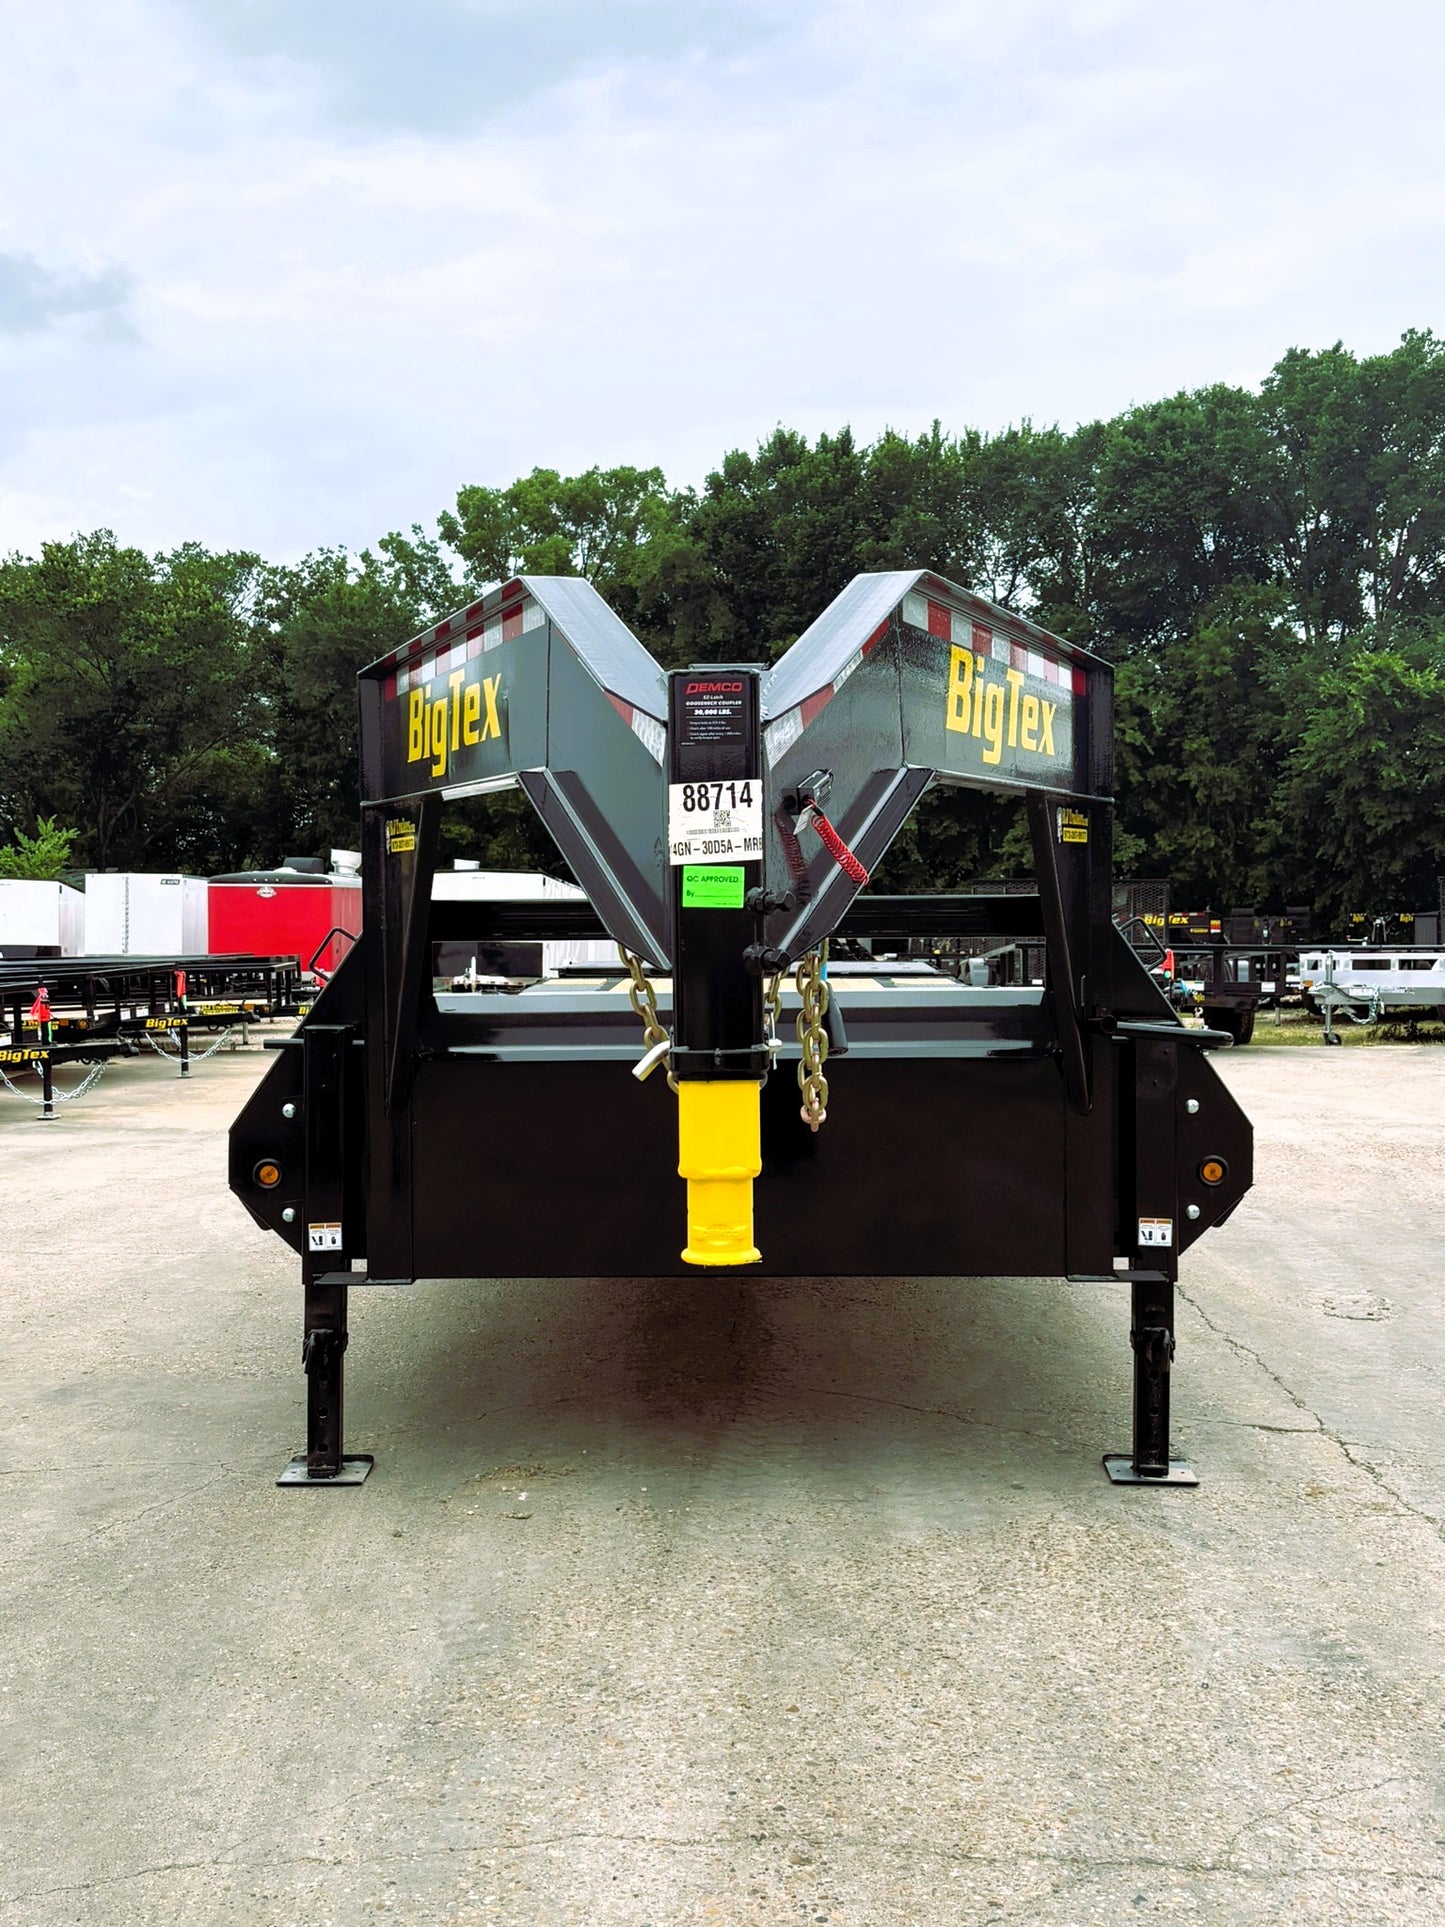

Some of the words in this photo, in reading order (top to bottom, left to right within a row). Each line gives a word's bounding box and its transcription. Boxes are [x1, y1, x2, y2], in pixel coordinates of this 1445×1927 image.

[685, 682, 743, 695] DEMCO
[946, 643, 1058, 765] BigTex
[407, 667, 502, 778] BigTex
[682, 781, 754, 812] 88714
[700, 875, 739, 883] APPROVED
[686, 889, 695, 898] By
[145, 1017, 189, 1030] BigTex
[0, 1049, 50, 1063] BigTex
